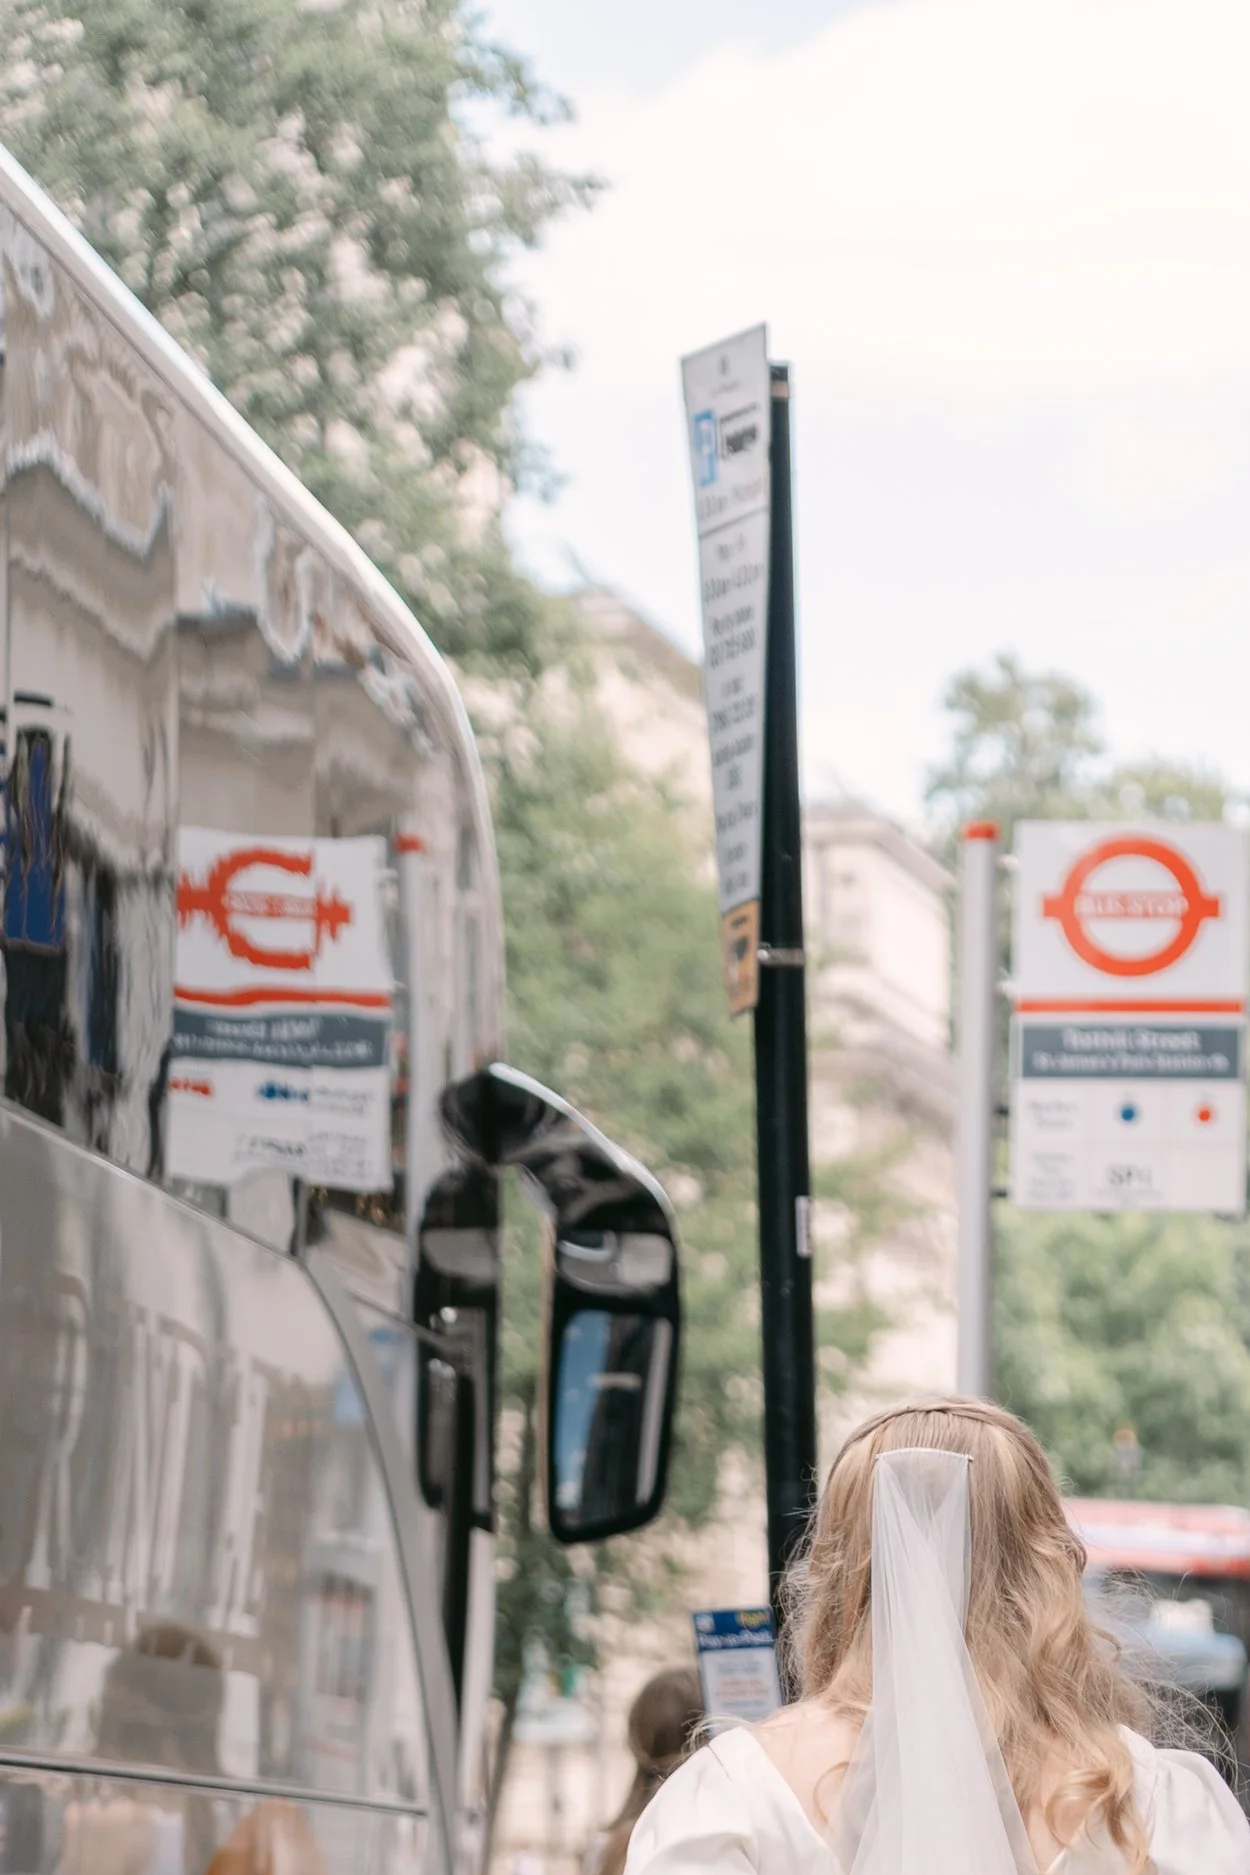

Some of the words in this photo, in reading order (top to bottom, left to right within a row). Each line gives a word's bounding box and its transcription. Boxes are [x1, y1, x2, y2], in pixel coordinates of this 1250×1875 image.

[1073, 895, 1127, 918] BUS
[1130, 895, 1190, 918] STOP
[1135, 1028, 1201, 1050] Street
